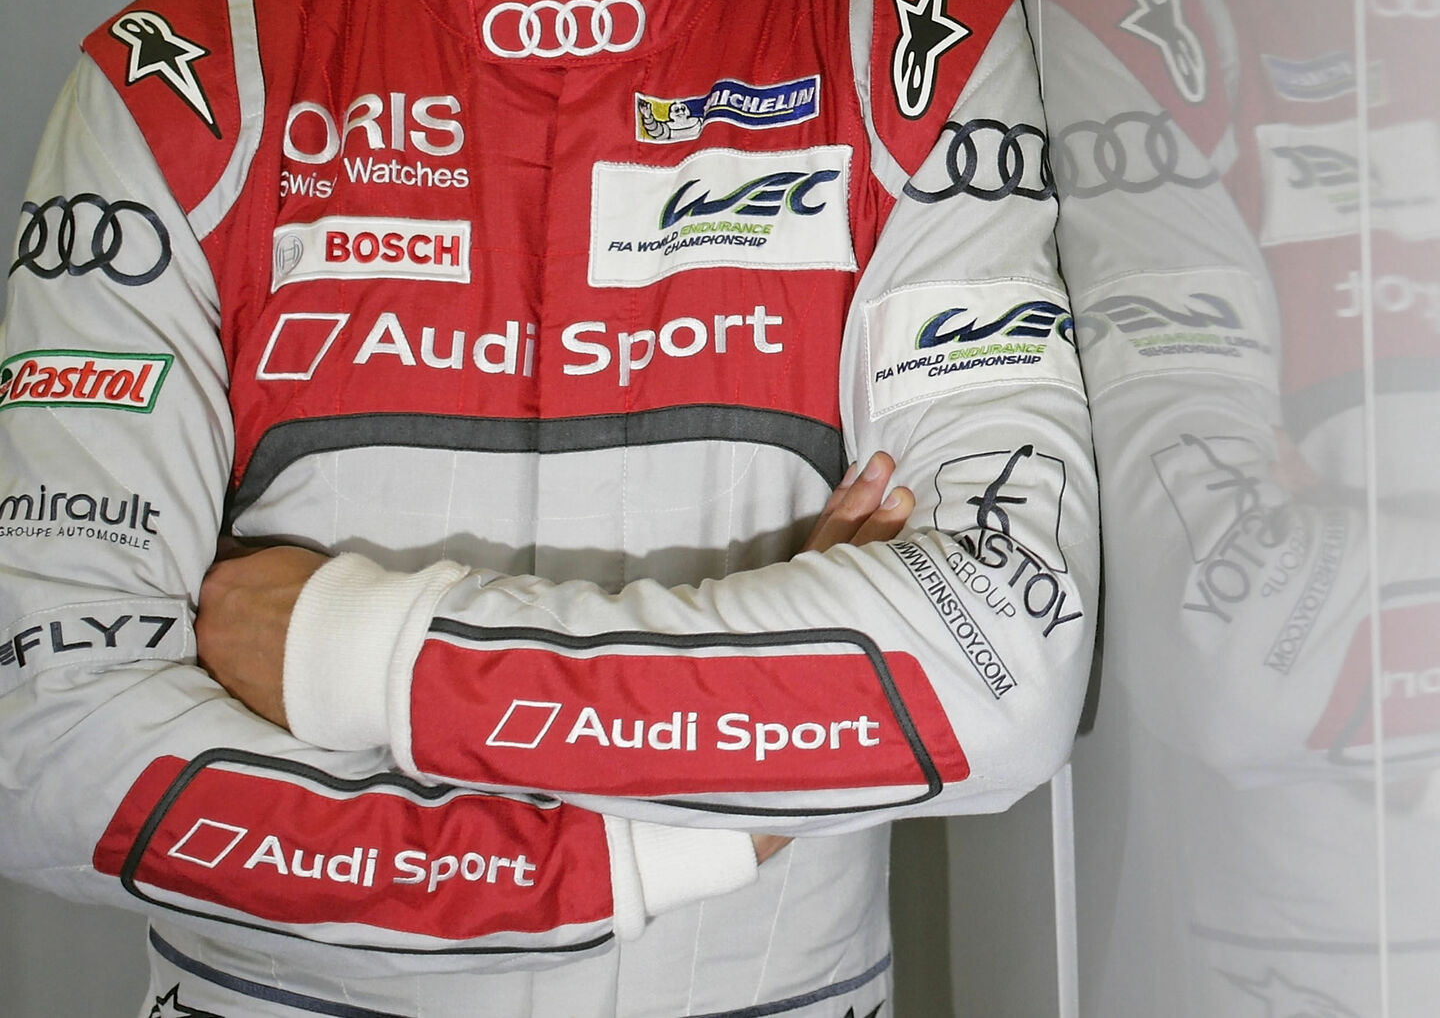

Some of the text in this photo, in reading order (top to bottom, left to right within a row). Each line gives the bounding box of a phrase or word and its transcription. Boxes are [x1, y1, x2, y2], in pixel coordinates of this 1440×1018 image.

[704, 86, 815, 114] MICHELIN
[283, 92, 465, 165] ORIS
[280, 157, 469, 199] Swis Watches
[659, 169, 841, 230] WEC
[325, 231, 460, 266] BOSCH
[608, 221, 774, 253] FIA WORLD ENDURANCE
[664, 234, 767, 257] CHAMPIONSHIP
[353, 305, 784, 386] Audi Sport
[875, 343, 1048, 382] FIA WORLD ENDURANCE
[927, 354, 1042, 378] CHAMPIONSHIP
[10, 359, 153, 404] Castrol
[0, 484, 160, 535] mirault
[0, 526, 150, 551] GROUPE AUTOMOBILE
[946, 551, 1017, 618] GROUP
[13, 614, 178, 668] FLY7
[566, 705, 880, 761] Audi Sport
[244, 834, 537, 894] Audi Sport
